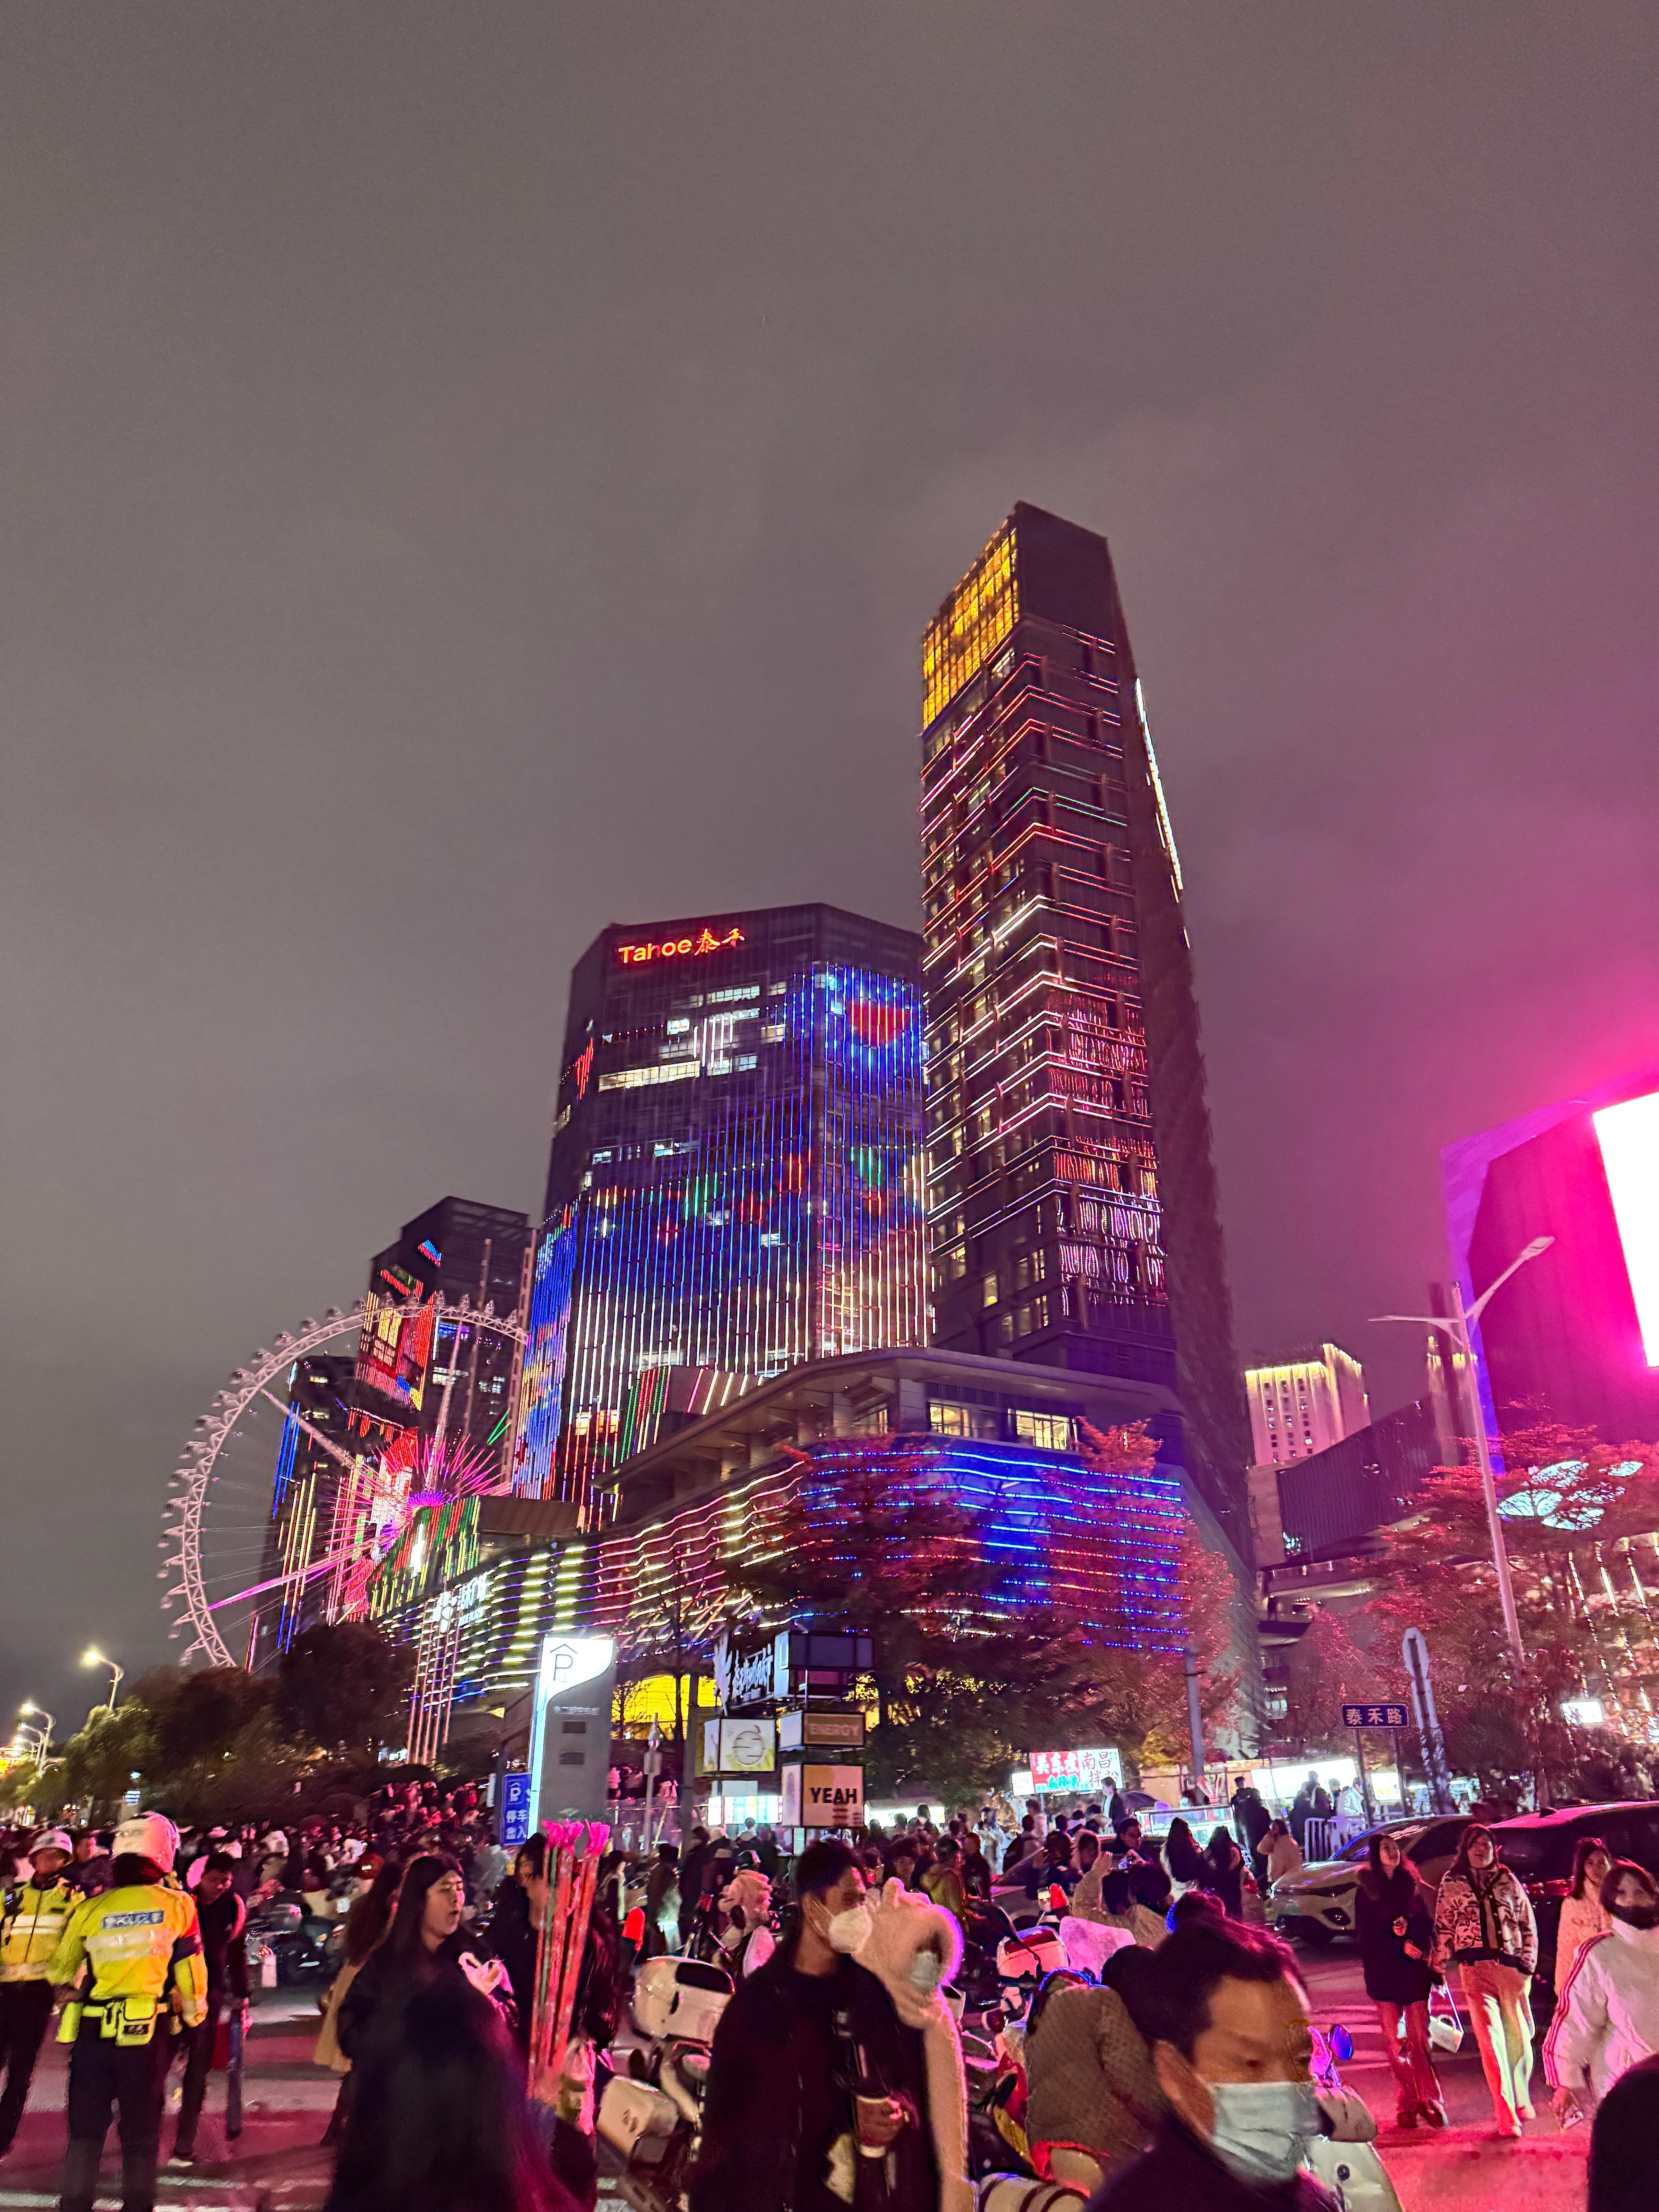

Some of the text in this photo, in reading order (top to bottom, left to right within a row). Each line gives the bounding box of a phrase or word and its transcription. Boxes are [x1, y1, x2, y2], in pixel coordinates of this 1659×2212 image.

[618, 928, 745, 963] Tahoe 泰禾
[553, 1654, 573, 1681] P
[1346, 1707, 1402, 1725] 泰禾路
[1082, 1752, 1111, 1770] 南昌
[810, 1787, 857, 1804] YEAH
